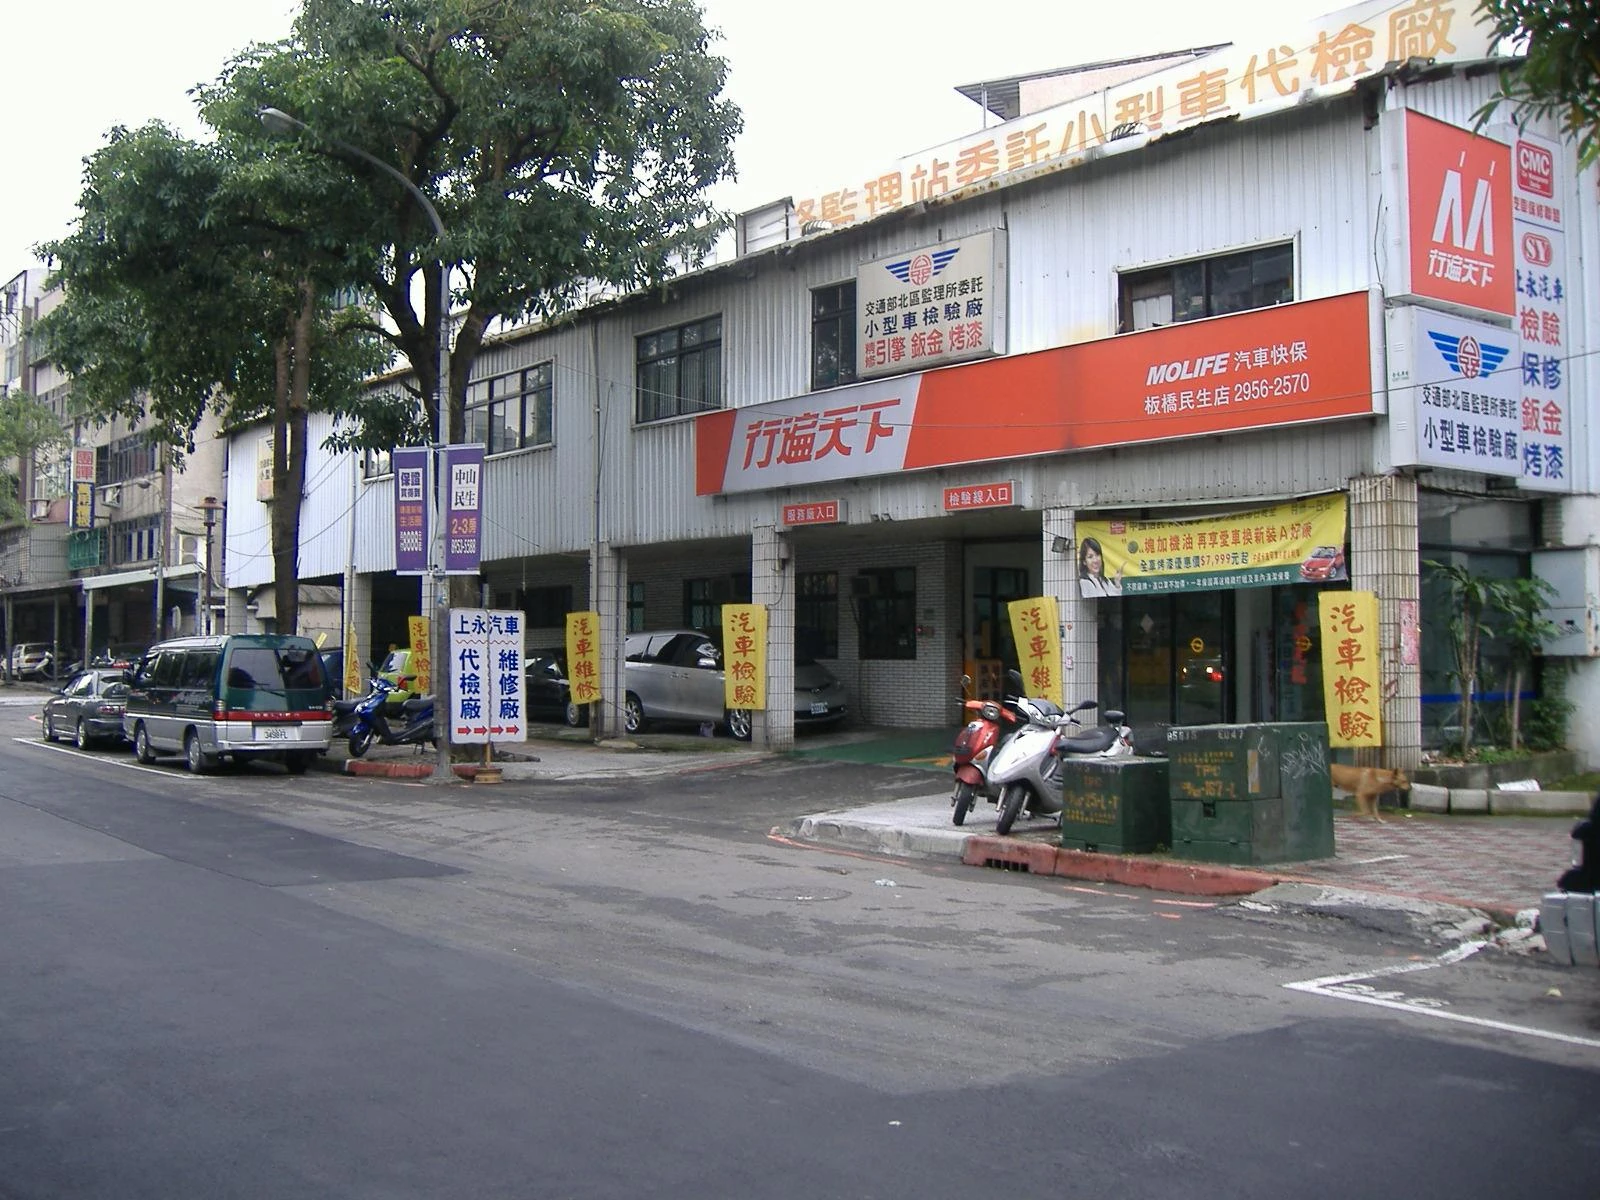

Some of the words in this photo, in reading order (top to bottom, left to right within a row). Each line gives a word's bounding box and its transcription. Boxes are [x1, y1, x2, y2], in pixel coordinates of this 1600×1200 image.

[1520, 148, 1550, 176] CMC
[1428, 249, 1495, 287] 行遍天下
[1525, 236, 1550, 262] SY
[865, 276, 983, 317] 交通部北區監理所委託
[864, 298, 983, 338] 小型車檢驗廠
[1520, 306, 1561, 347] 檢驗
[876, 336, 906, 365] 引擎
[911, 328, 943, 359] 鈑金
[949, 320, 983, 351] 烤漆
[1146, 352, 1230, 386] MOLIFE
[1234, 341, 1308, 372] 汽車快保
[1522, 351, 1562, 390] 保修
[1144, 386, 1230, 415] 板橋民生店
[1234, 372, 1309, 402] 2956-2570
[743, 398, 901, 471] 行遍天下
[1521, 397, 1562, 436] 鈑金
[1424, 416, 1518, 460] 小型車檢驗廠
[455, 469, 476, 485] 中山
[1523, 442, 1563, 479] 烤漆
[454, 491, 476, 506] 民生
[786, 505, 835, 521] 服務廠入口
[949, 487, 1009, 506] 檢驗線入口
[455, 615, 519, 635] 上永汽車
[573, 620, 599, 699] 汽車維修
[731, 612, 756, 705] 汽車檢驗
[1021, 606, 1052, 699] 汽車維
[1329, 603, 1375, 741] 汽車檢驗
[459, 649, 481, 720] 代檢廠
[498, 649, 519, 720] 維修廠
